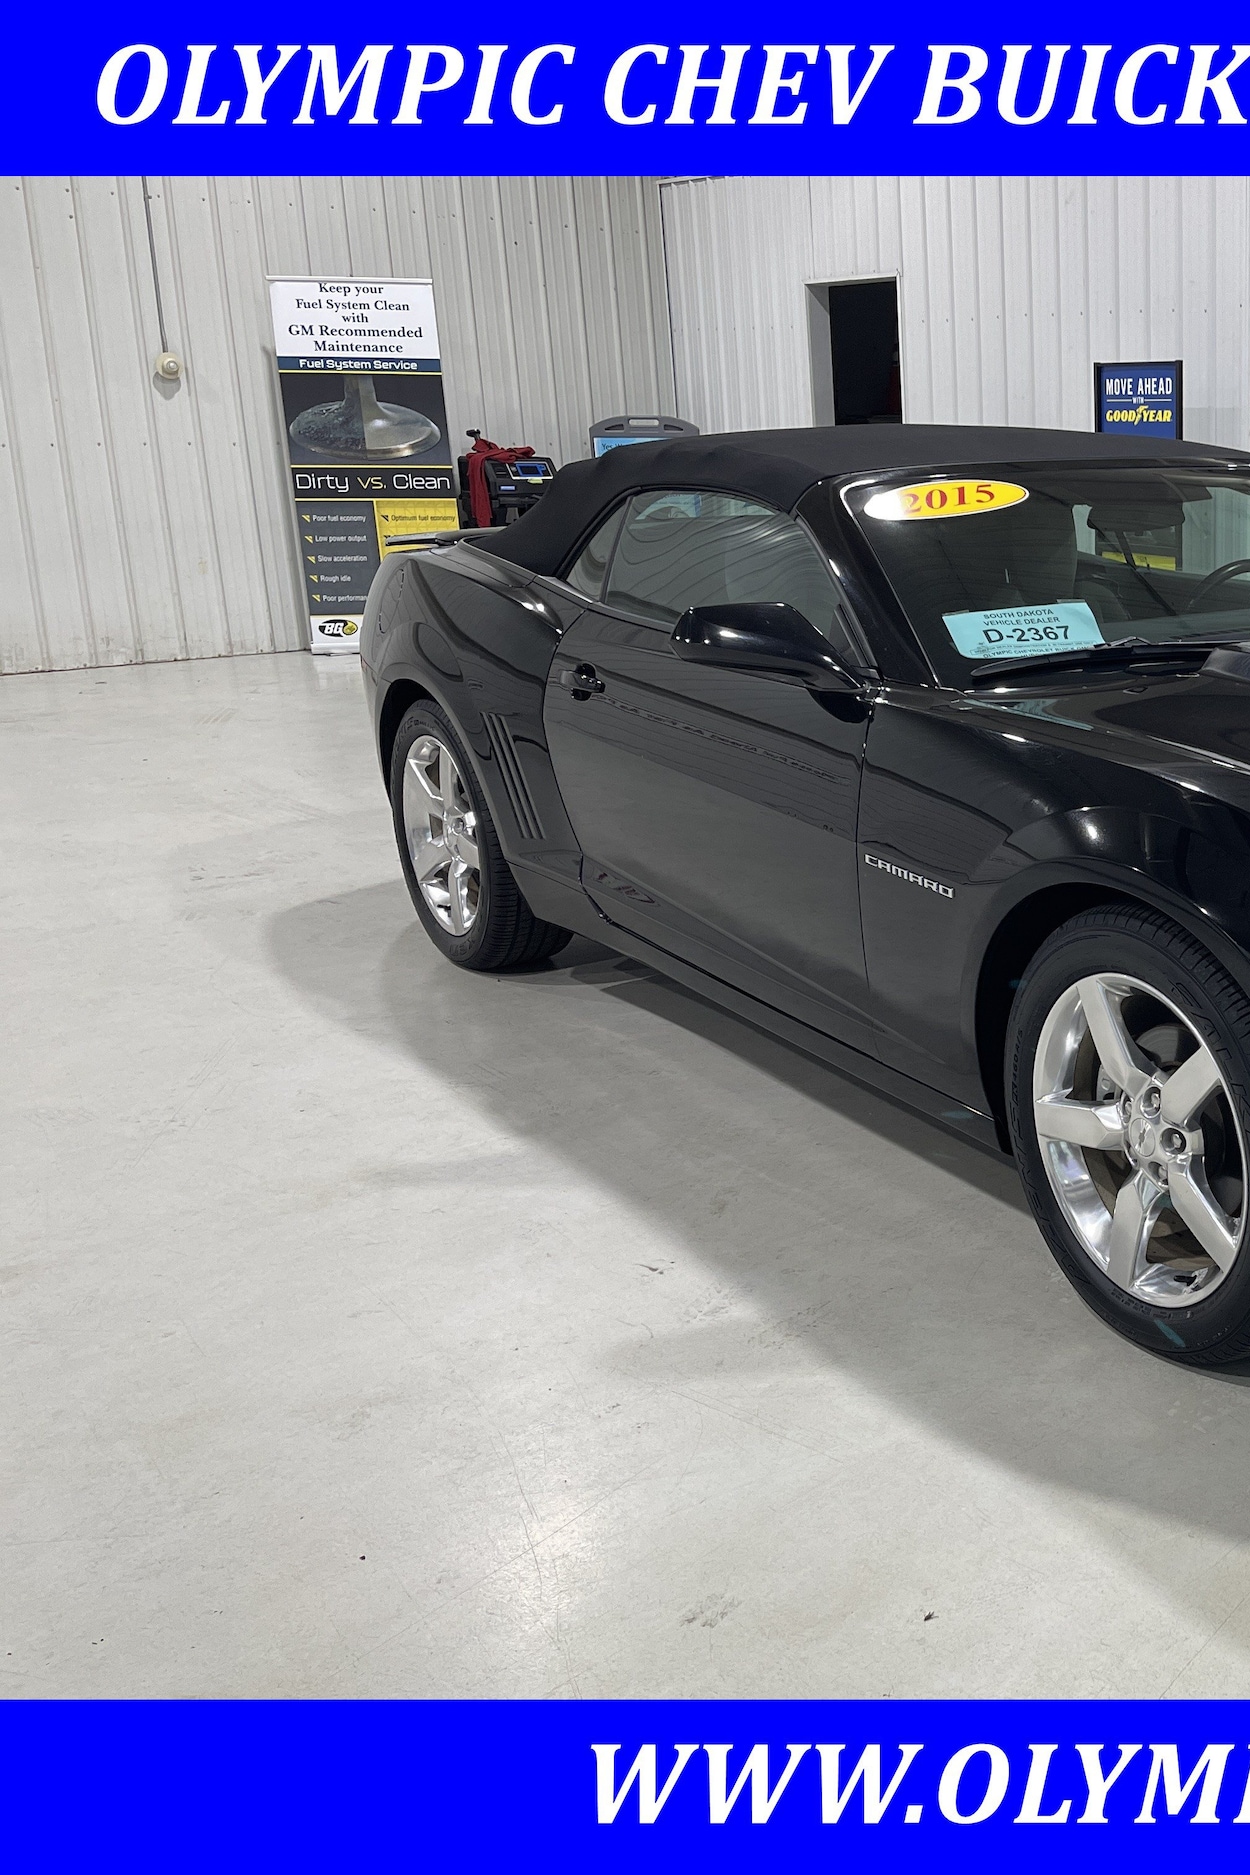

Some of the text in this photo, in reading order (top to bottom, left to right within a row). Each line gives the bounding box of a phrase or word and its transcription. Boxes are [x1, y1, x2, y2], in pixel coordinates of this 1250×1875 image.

[318, 283, 384, 296] Keep your
[295, 299, 410, 313] Fuel System Clean
[341, 313, 369, 323] with
[288, 325, 423, 338] GM Recommended
[314, 341, 403, 353] Maintenance
[299, 359, 417, 370] Fuel System Service
[1106, 377, 1172, 395] MOVE AHEAD
[1105, 407, 1172, 424] GOODYEAR
[295, 474, 450, 492] Dirty vs. Clean
[903, 483, 995, 514] 2015
[340, 515, 366, 523] economy
[348, 535, 367, 543] output
[320, 575, 339, 583] Rough
[338, 595, 368, 603] performan
[984, 609, 1054, 619] SOUTH DAKOTA
[984, 617, 1060, 626] VEHICLE DEALER
[324, 622, 344, 634] BG
[983, 626, 1069, 643] D-2367
[864, 853, 954, 899] CAMARO
